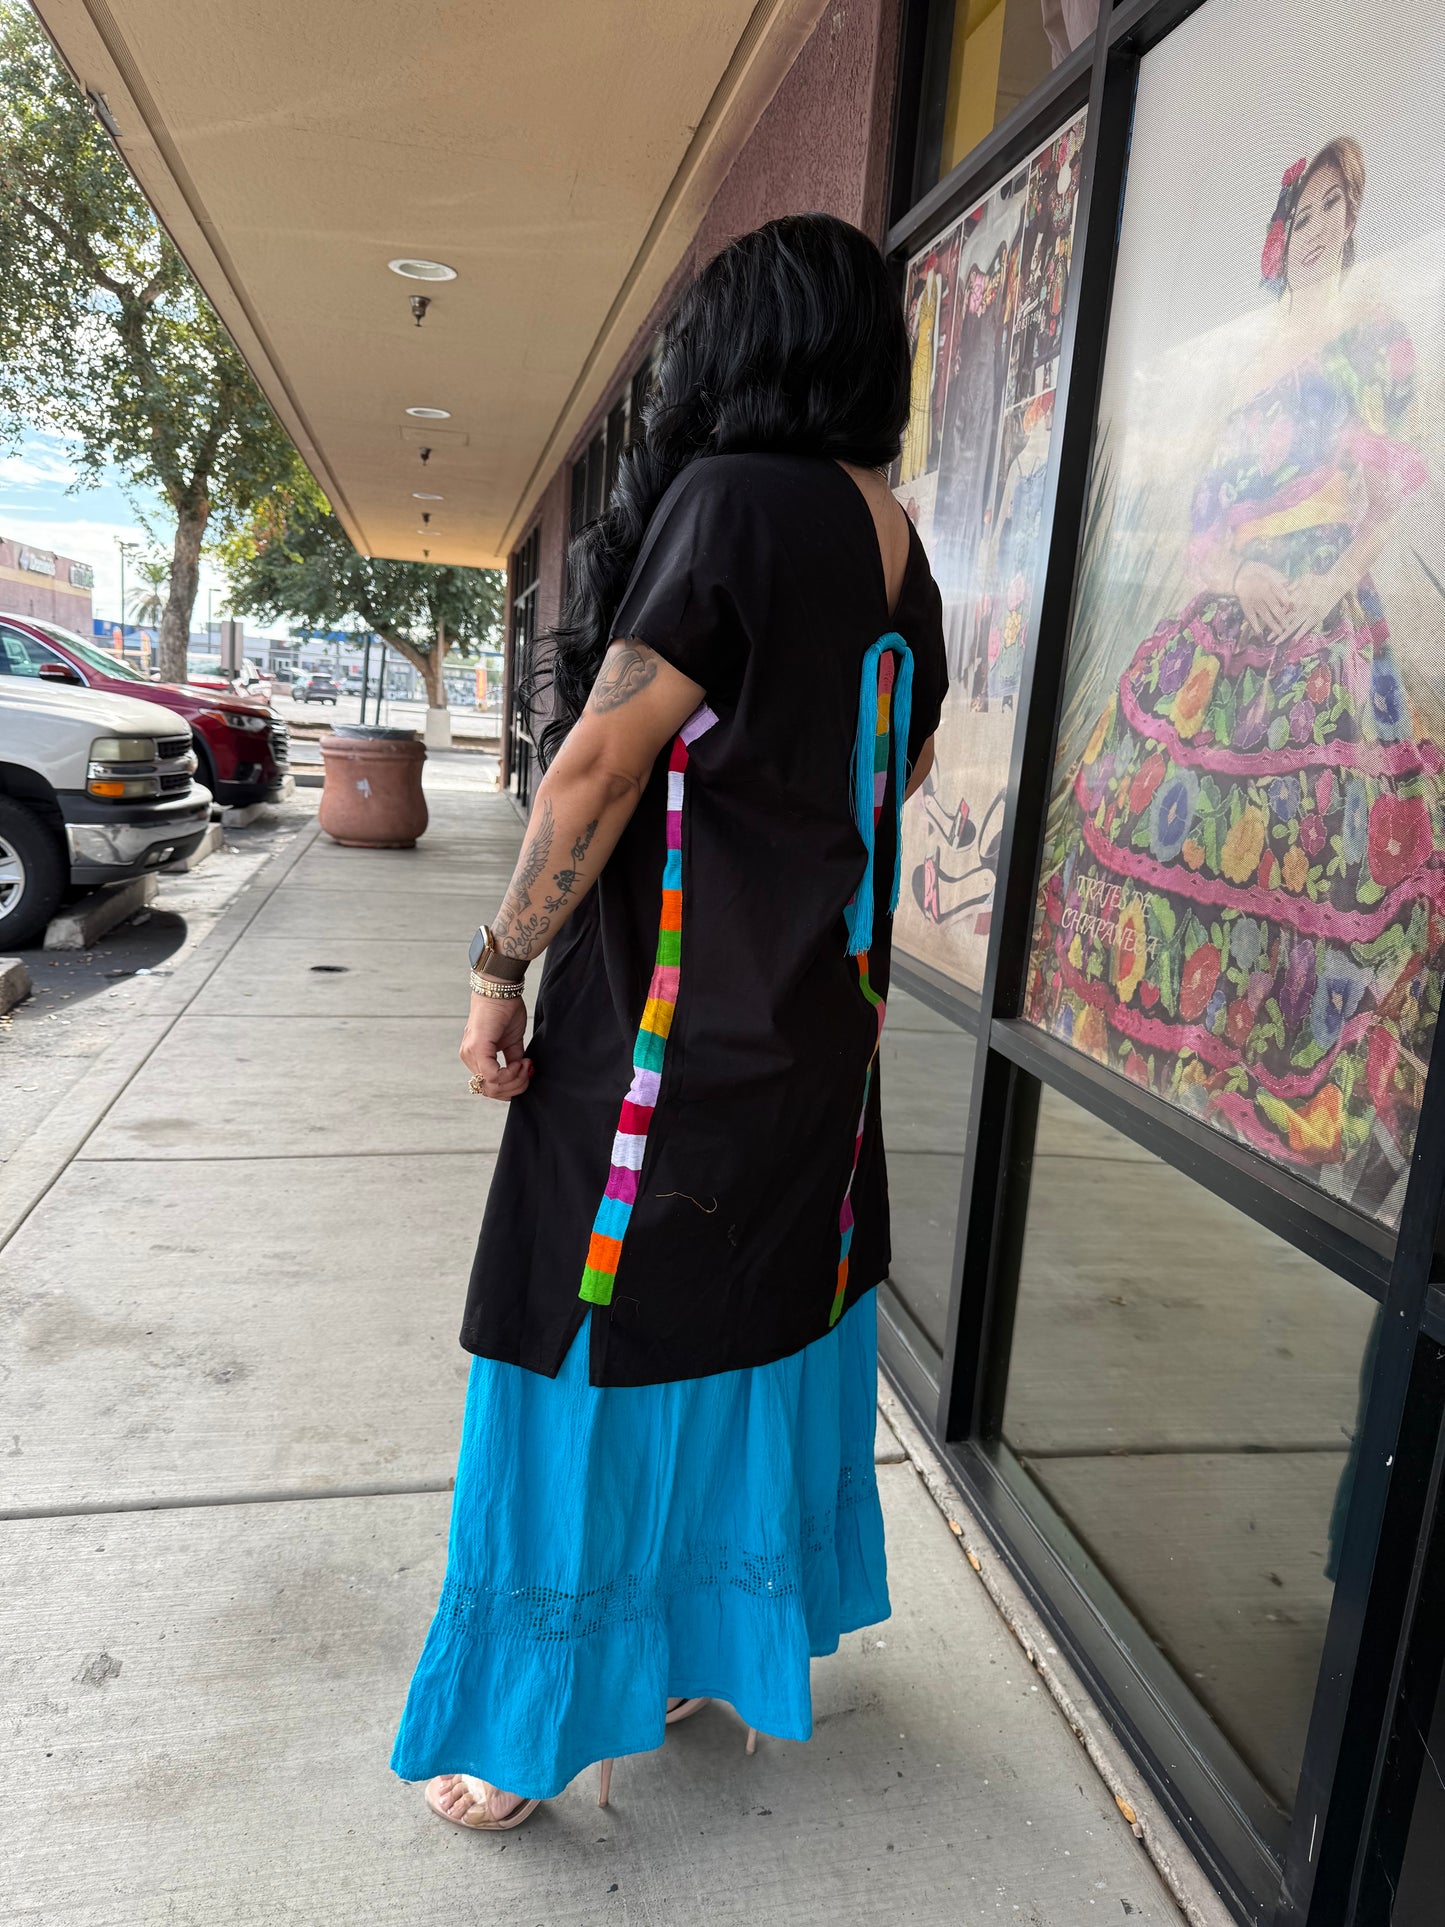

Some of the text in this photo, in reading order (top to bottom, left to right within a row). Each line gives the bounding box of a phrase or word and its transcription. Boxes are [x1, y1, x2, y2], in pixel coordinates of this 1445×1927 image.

[1077, 875, 1154, 918] TRAJES DE
[502, 913, 539, 959] Pedro
